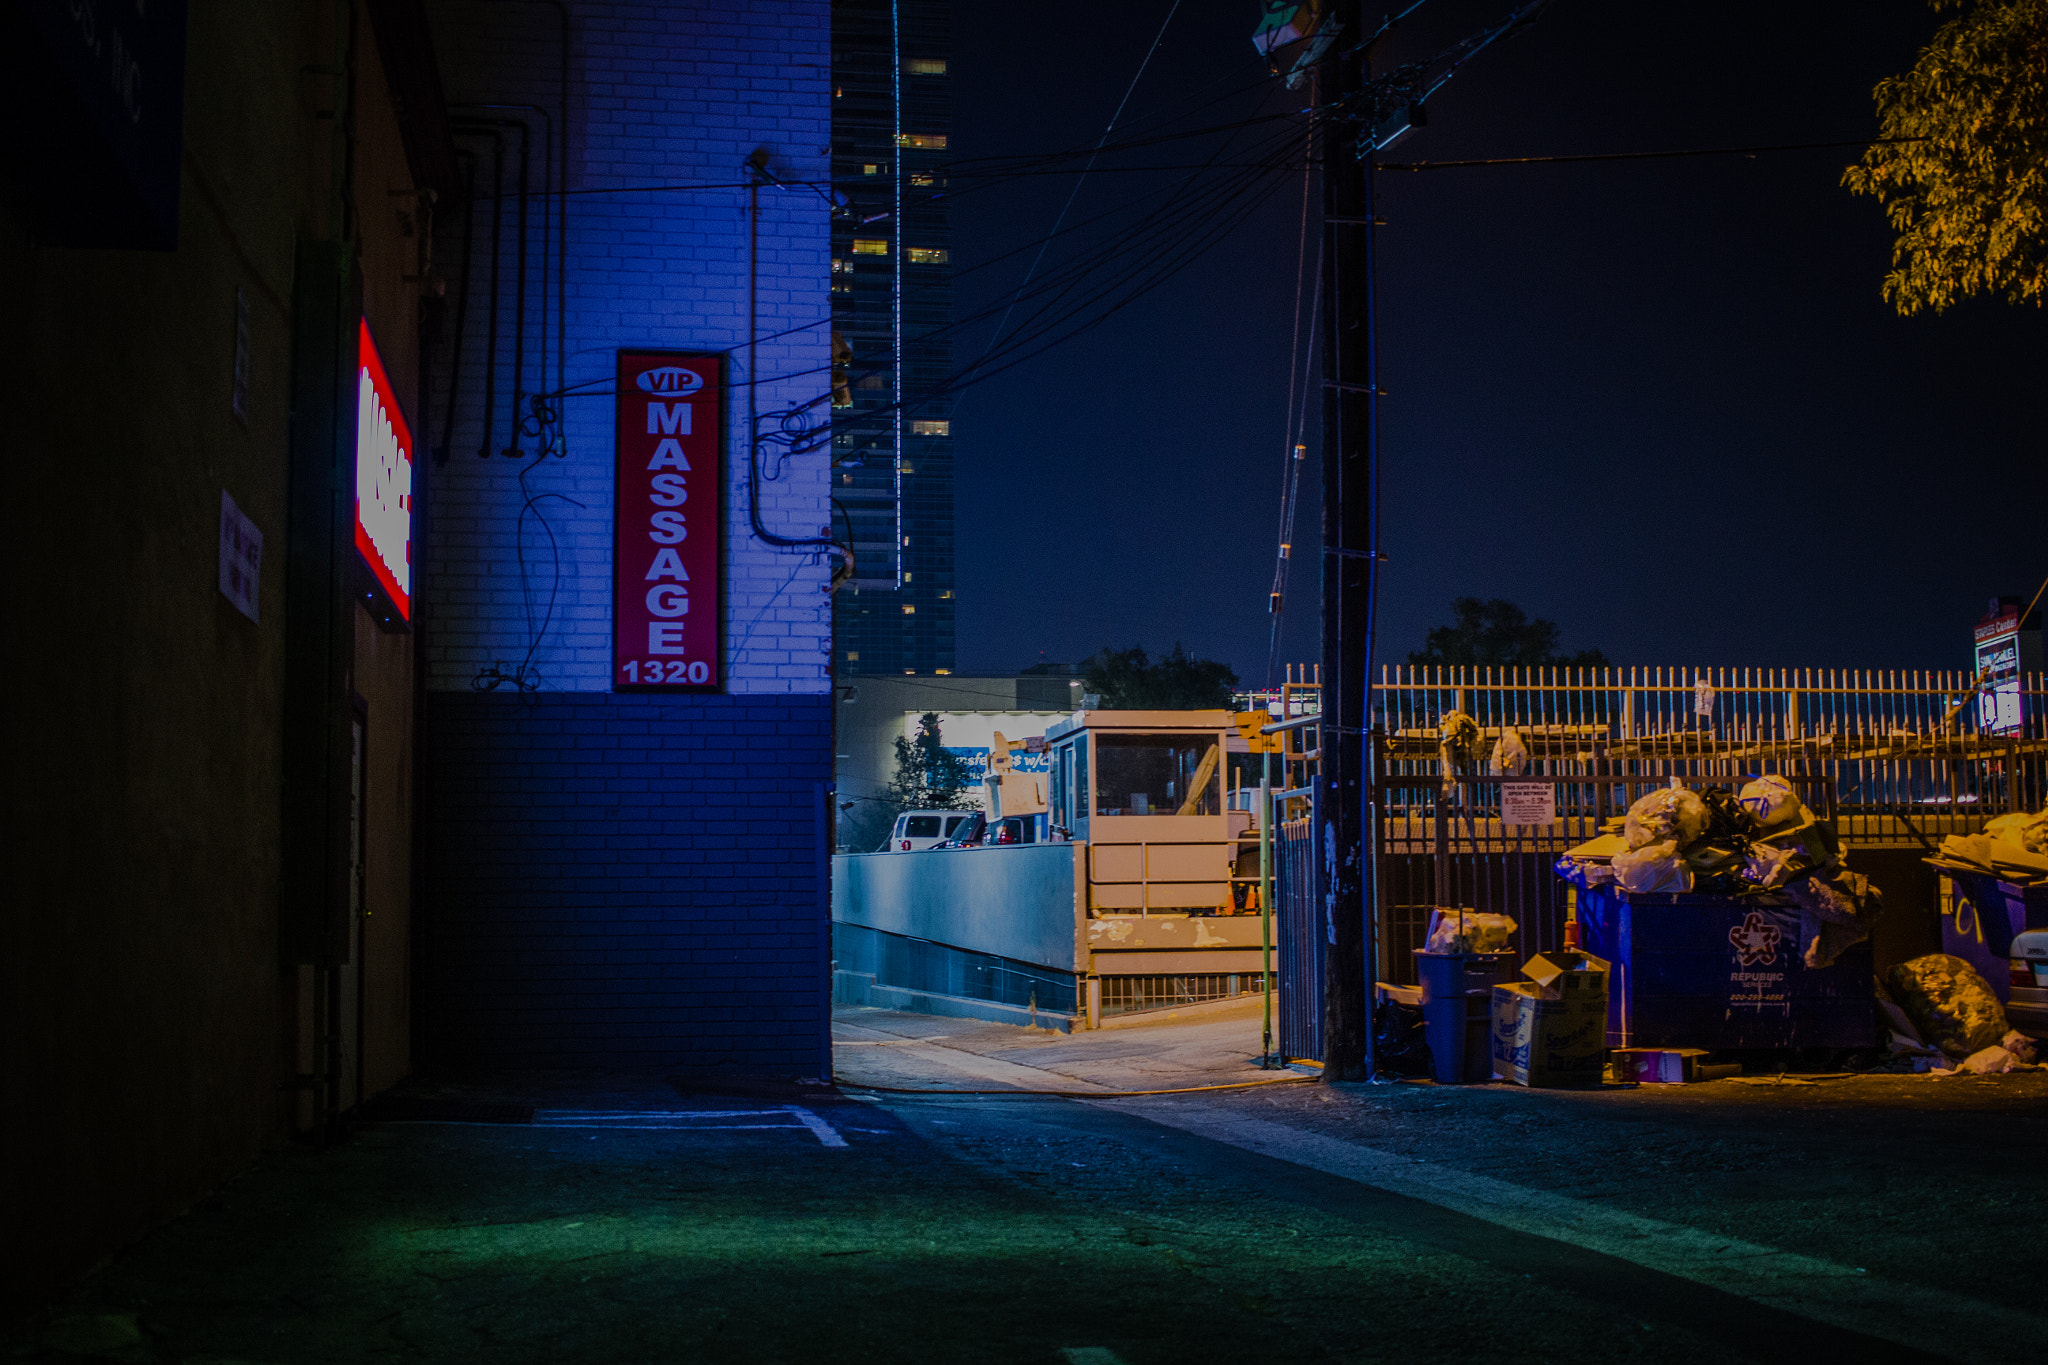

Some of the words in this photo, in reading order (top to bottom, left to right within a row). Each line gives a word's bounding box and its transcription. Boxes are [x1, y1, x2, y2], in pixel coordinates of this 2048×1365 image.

[647, 371, 694, 392] VIP
[645, 402, 693, 655] MASSAGE
[621, 660, 709, 684] 1320
[1730, 972, 1785, 981] REPUBLIC
